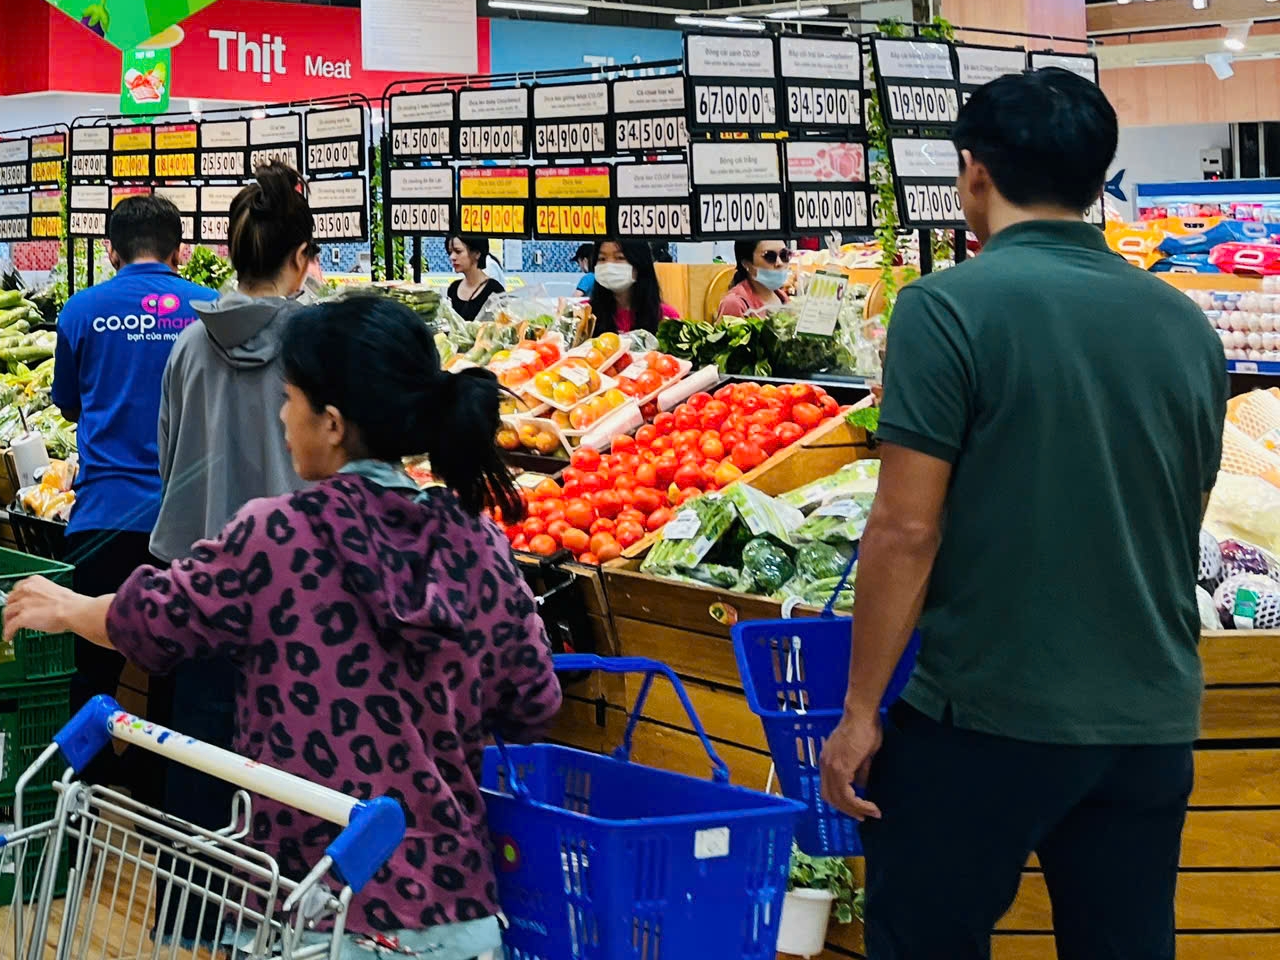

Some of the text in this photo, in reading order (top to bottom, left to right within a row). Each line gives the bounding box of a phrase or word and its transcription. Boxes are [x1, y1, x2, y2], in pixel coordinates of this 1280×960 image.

[209, 28, 351, 83] Thịt Meat
[700, 92, 760, 115] 67.000
[791, 92, 847, 115] 34.500
[893, 91, 946, 114] 19.900
[394, 132, 437, 150] 64.500
[462, 131, 510, 148] 31.900
[538, 127, 589, 148] 34.900
[619, 123, 674, 141] 34.500
[394, 208, 437, 225] 60.500
[703, 199, 765, 224] 72.000
[797, 196, 852, 220] 00.000
[539, 210, 591, 230] 22.100
[621, 209, 679, 229] 23.500
[127, 333, 144, 342] bạn
[146, 332, 162, 341] của
